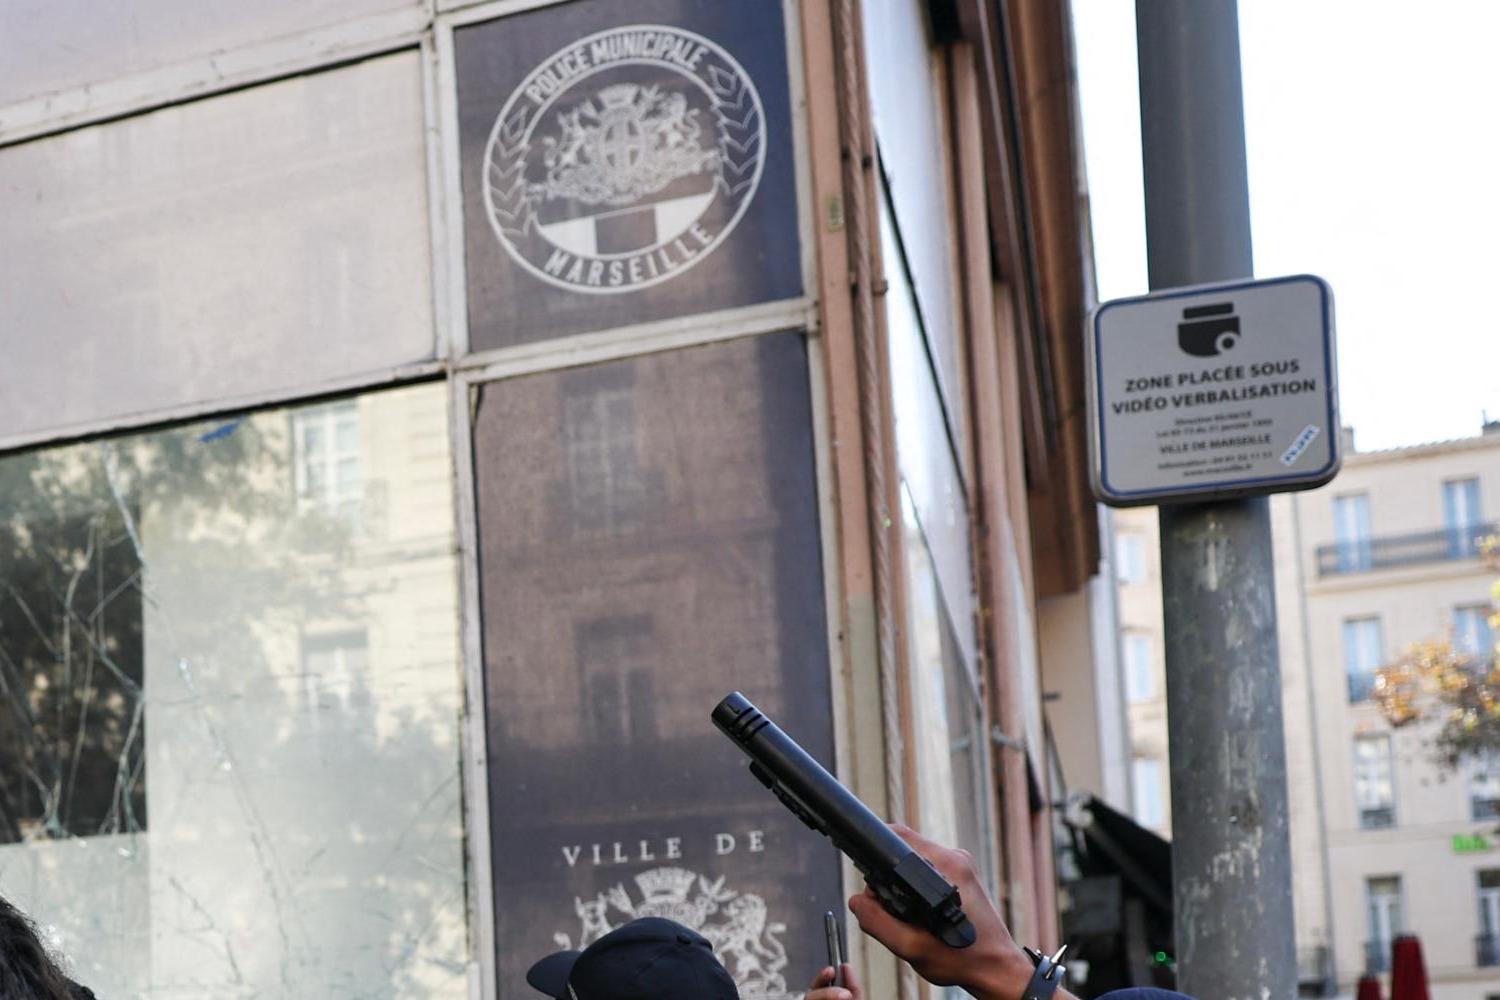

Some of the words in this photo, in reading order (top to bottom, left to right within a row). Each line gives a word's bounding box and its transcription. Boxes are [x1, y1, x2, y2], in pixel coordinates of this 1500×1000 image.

[526, 47, 590, 105] POLICE
[590, 31, 708, 72] MUNICIPALE
[545, 223, 714, 286] MARSEILLE
[1125, 375, 1173, 393] ZONE
[1178, 363, 1244, 386] PLACÉE
[1250, 359, 1300, 378] SOUS
[1112, 394, 1168, 415] VIDÉO
[1171, 379, 1316, 409] VERBALISATION
[562, 836, 681, 868] VILLE
[716, 829, 765, 856] DE
